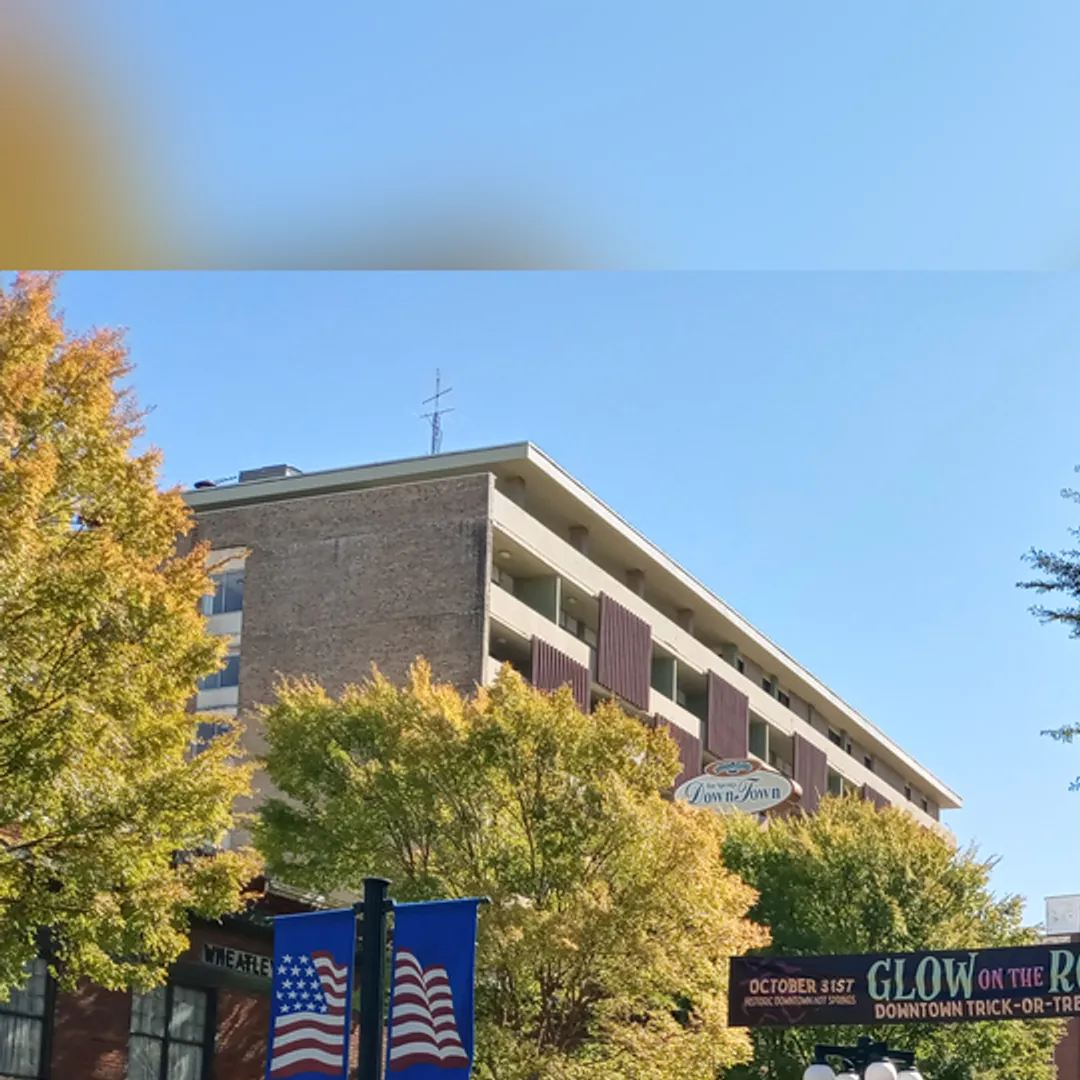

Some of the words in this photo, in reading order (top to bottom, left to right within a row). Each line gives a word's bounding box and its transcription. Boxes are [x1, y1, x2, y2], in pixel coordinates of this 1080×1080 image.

[204, 943, 275, 976] WHEATLE
[749, 978, 817, 995] OCTOBER
[820, 978, 855, 993] 31ST
[867, 952, 979, 1001] GLOW
[978, 968, 1004, 990] ON
[1007, 966, 1044, 988] THE
[875, 1001, 963, 1019] DOWNTOWN
